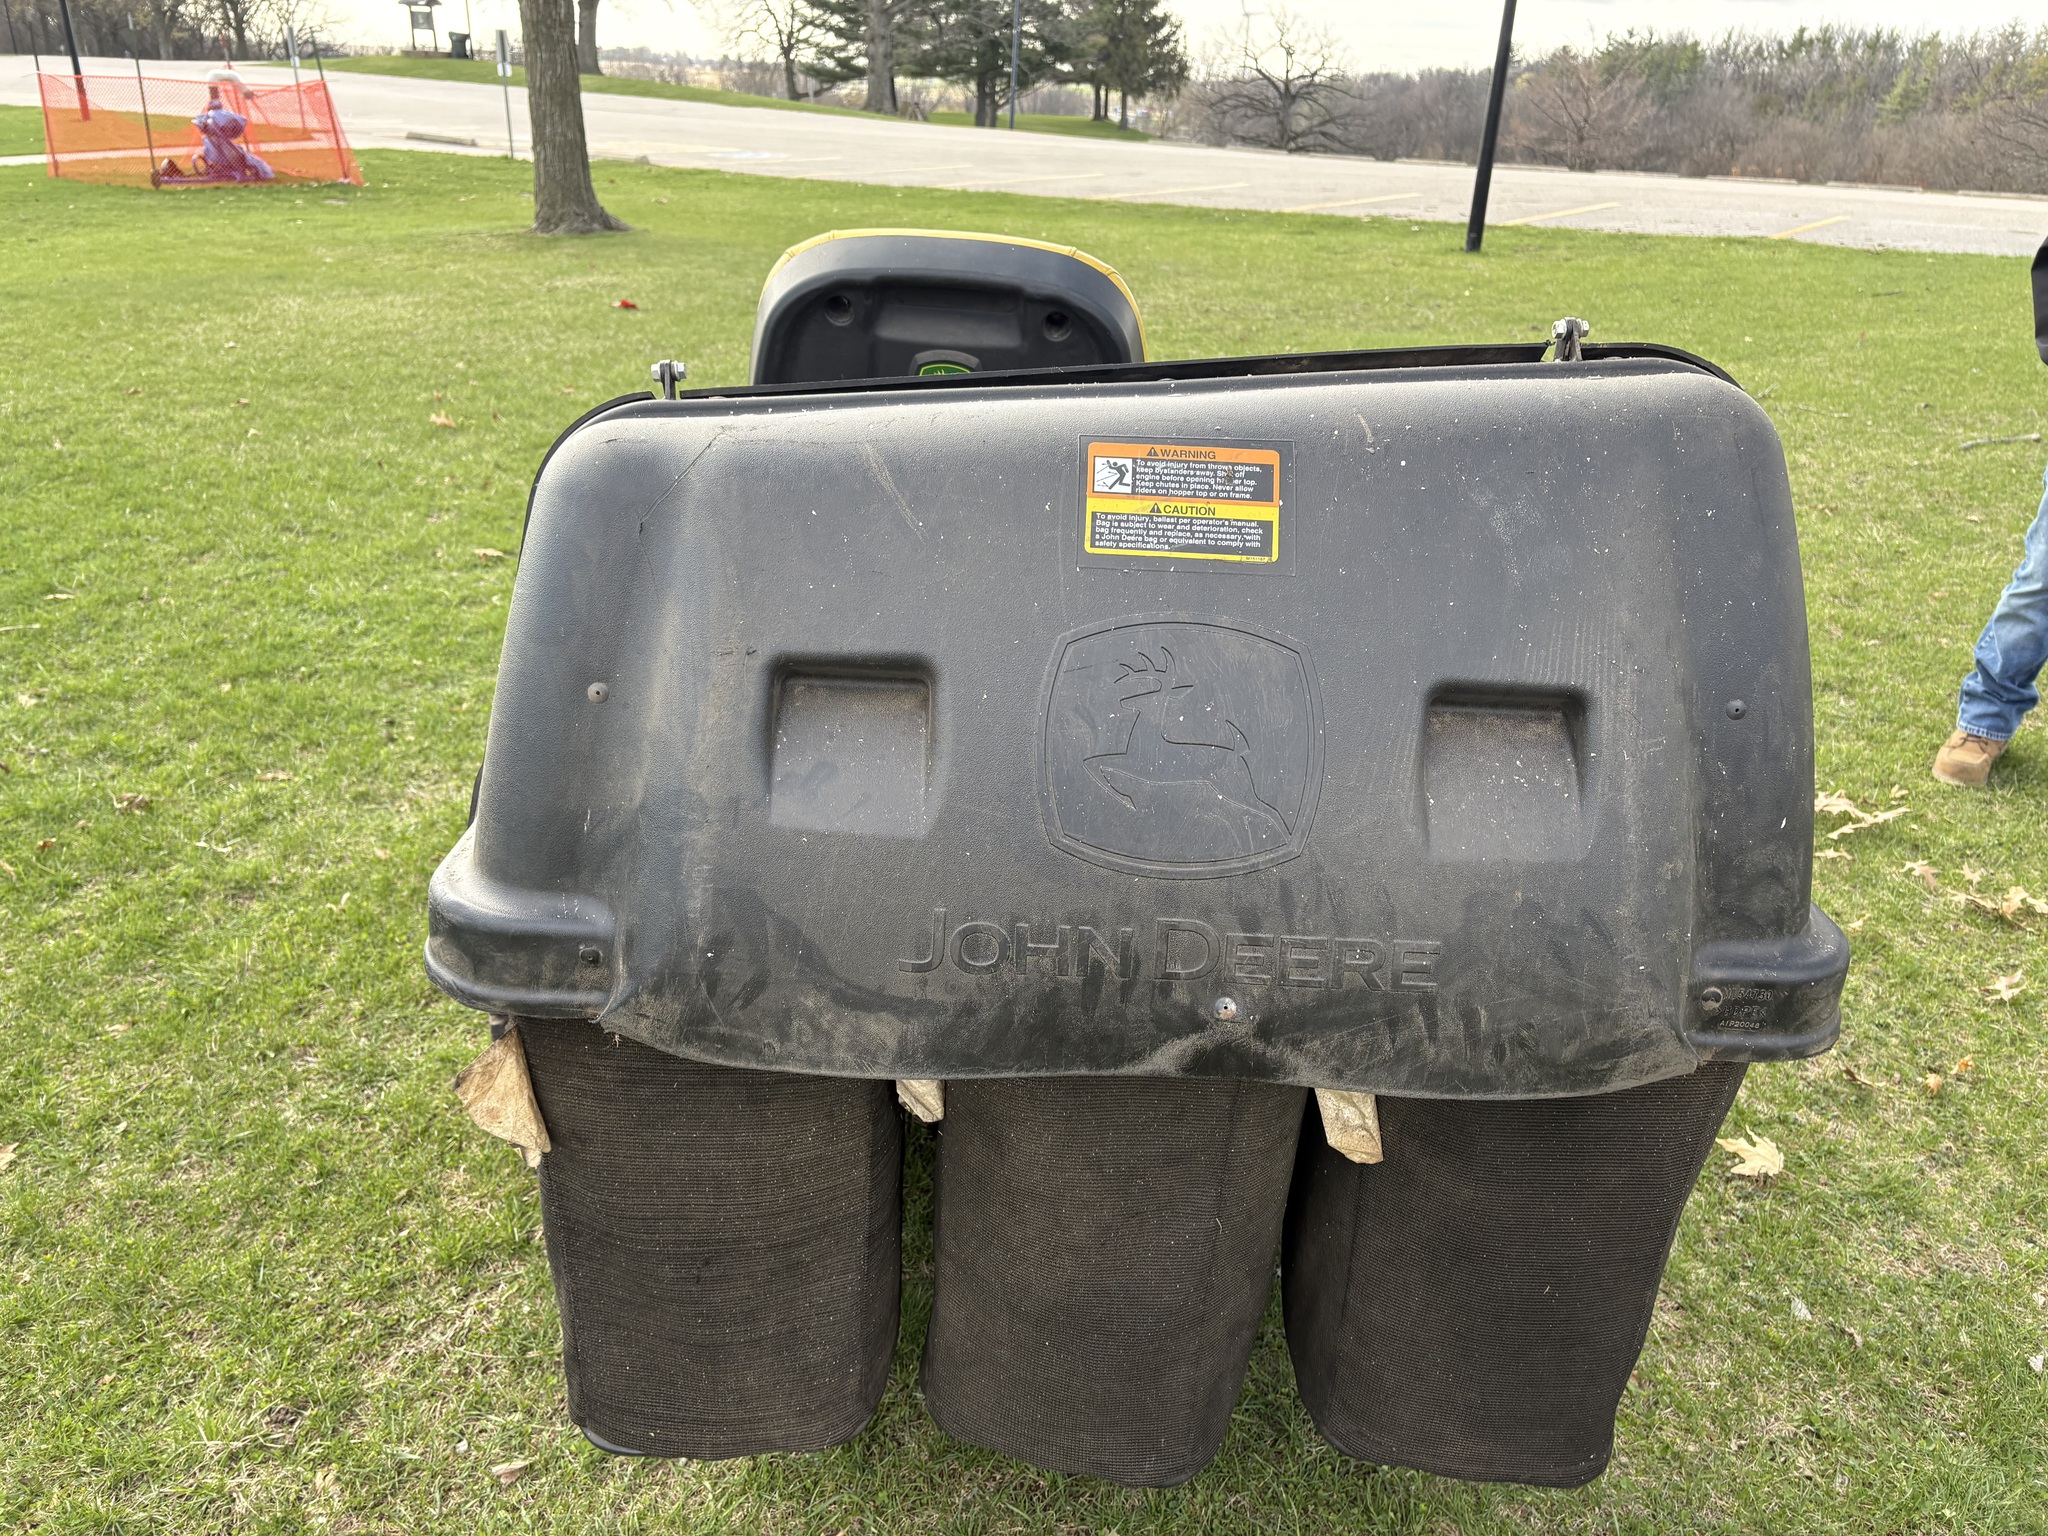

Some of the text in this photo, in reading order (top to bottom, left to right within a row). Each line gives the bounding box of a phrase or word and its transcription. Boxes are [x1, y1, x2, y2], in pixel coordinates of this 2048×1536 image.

[1160, 449, 1216, 459] WARNING
[1155, 467, 1194, 475] bystanders
[1163, 505, 1216, 516] CAUTION
[1111, 528, 1147, 536] frequently
[1165, 530, 1191, 538] replace,
[1119, 541, 1170, 549] specifications.
[1169, 537, 1206, 545] equivalent
[899, 906, 1443, 994] JOHN DEERE
